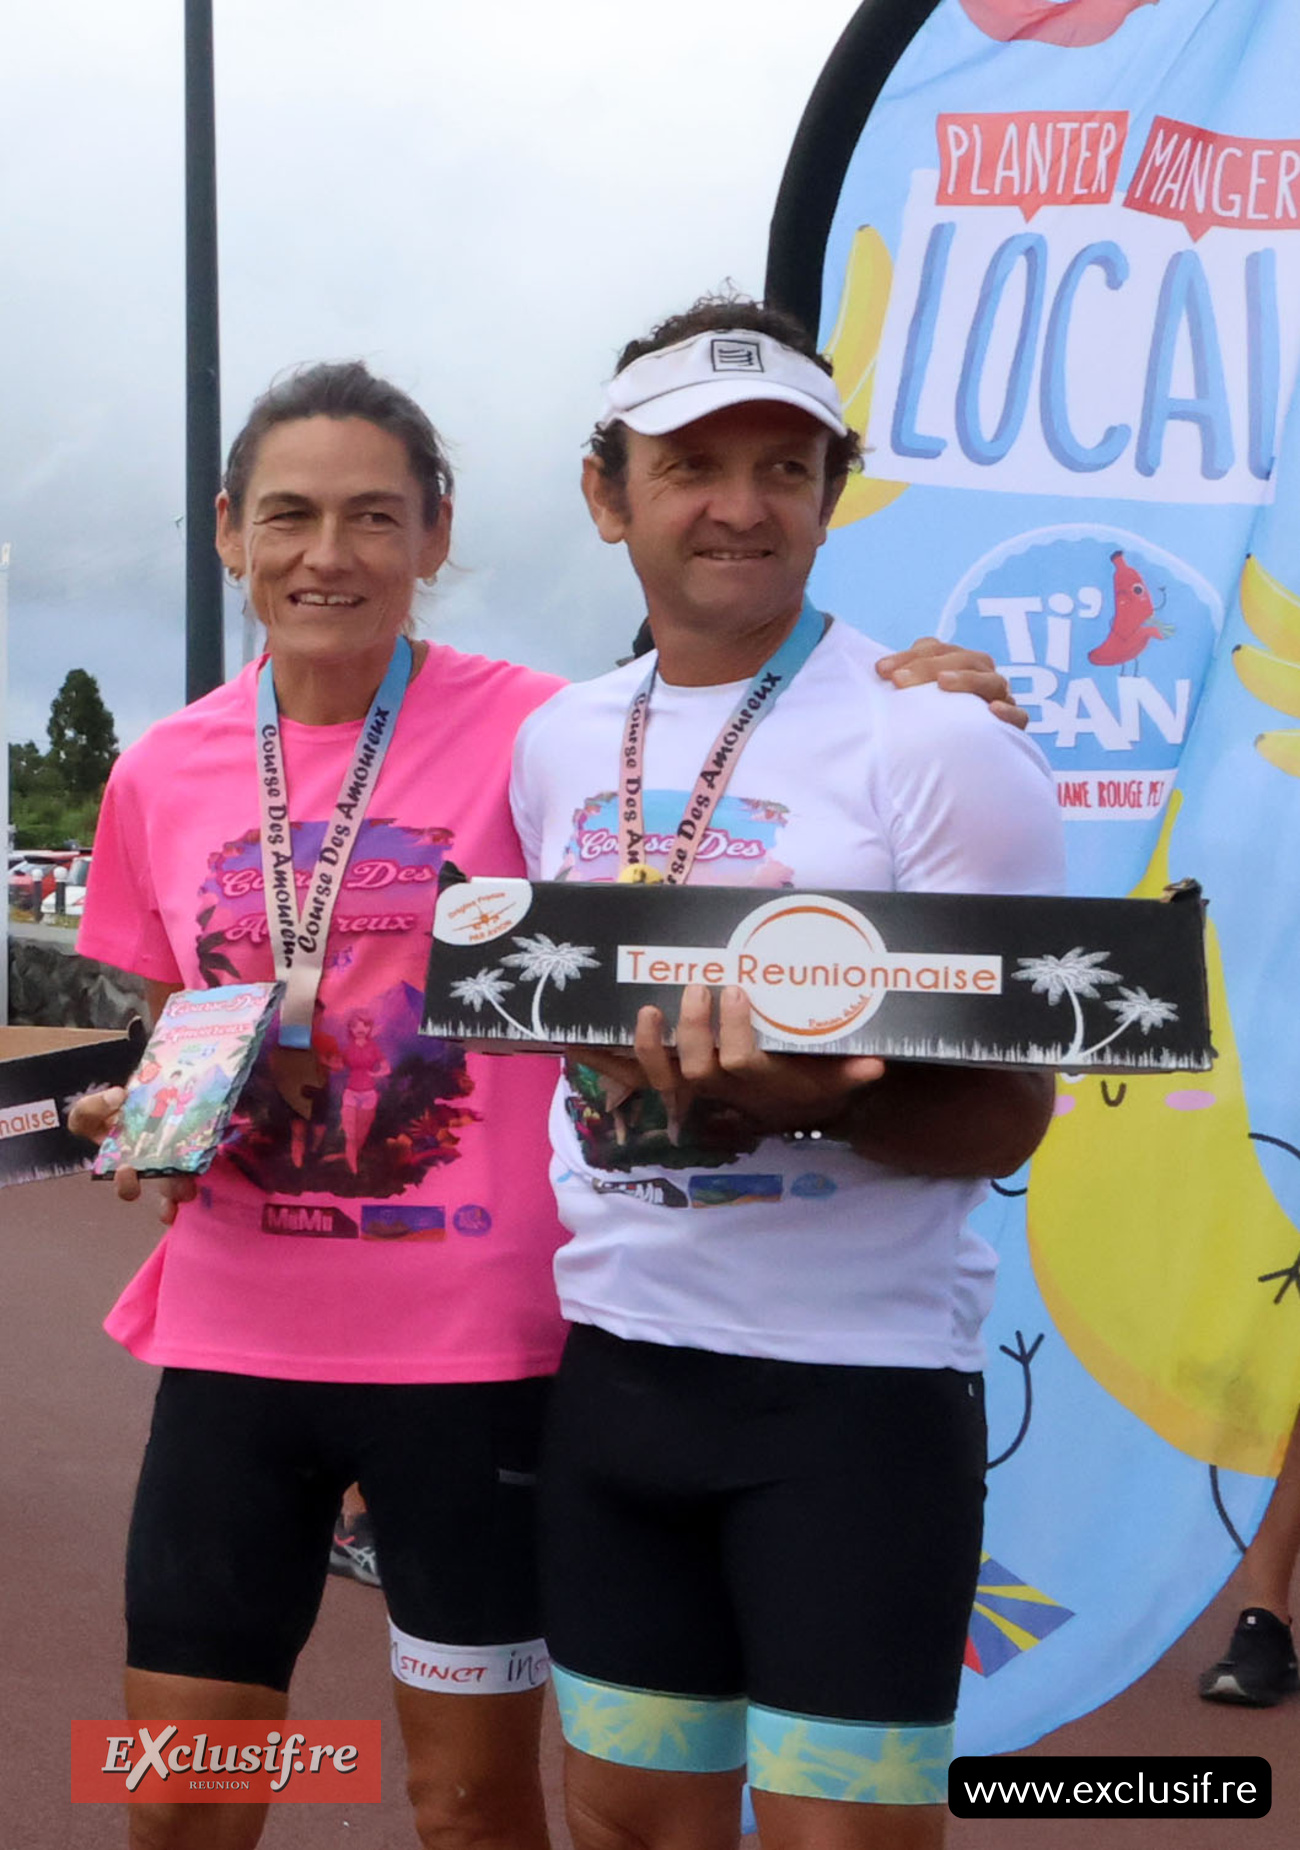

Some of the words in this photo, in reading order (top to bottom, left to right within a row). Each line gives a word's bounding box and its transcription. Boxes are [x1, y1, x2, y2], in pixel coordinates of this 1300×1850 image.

[946, 121, 1117, 195] PLANTER
[1134, 129, 1300, 219] MANGER
[261, 723, 281, 798] Course
[677, 794, 710, 841] Des
[700, 671, 782, 789] Amoureux
[267, 804, 288, 845] Des
[624, 776, 642, 822] Des
[1097, 780, 1143, 809] ROUGE
[298, 872, 333, 954] Course
[319, 823, 350, 867] Des
[336, 706, 390, 820] Amoureux
[346, 860, 434, 889] Des
[627, 951, 725, 983] Terre
[737, 954, 997, 991] Reunionnaise
